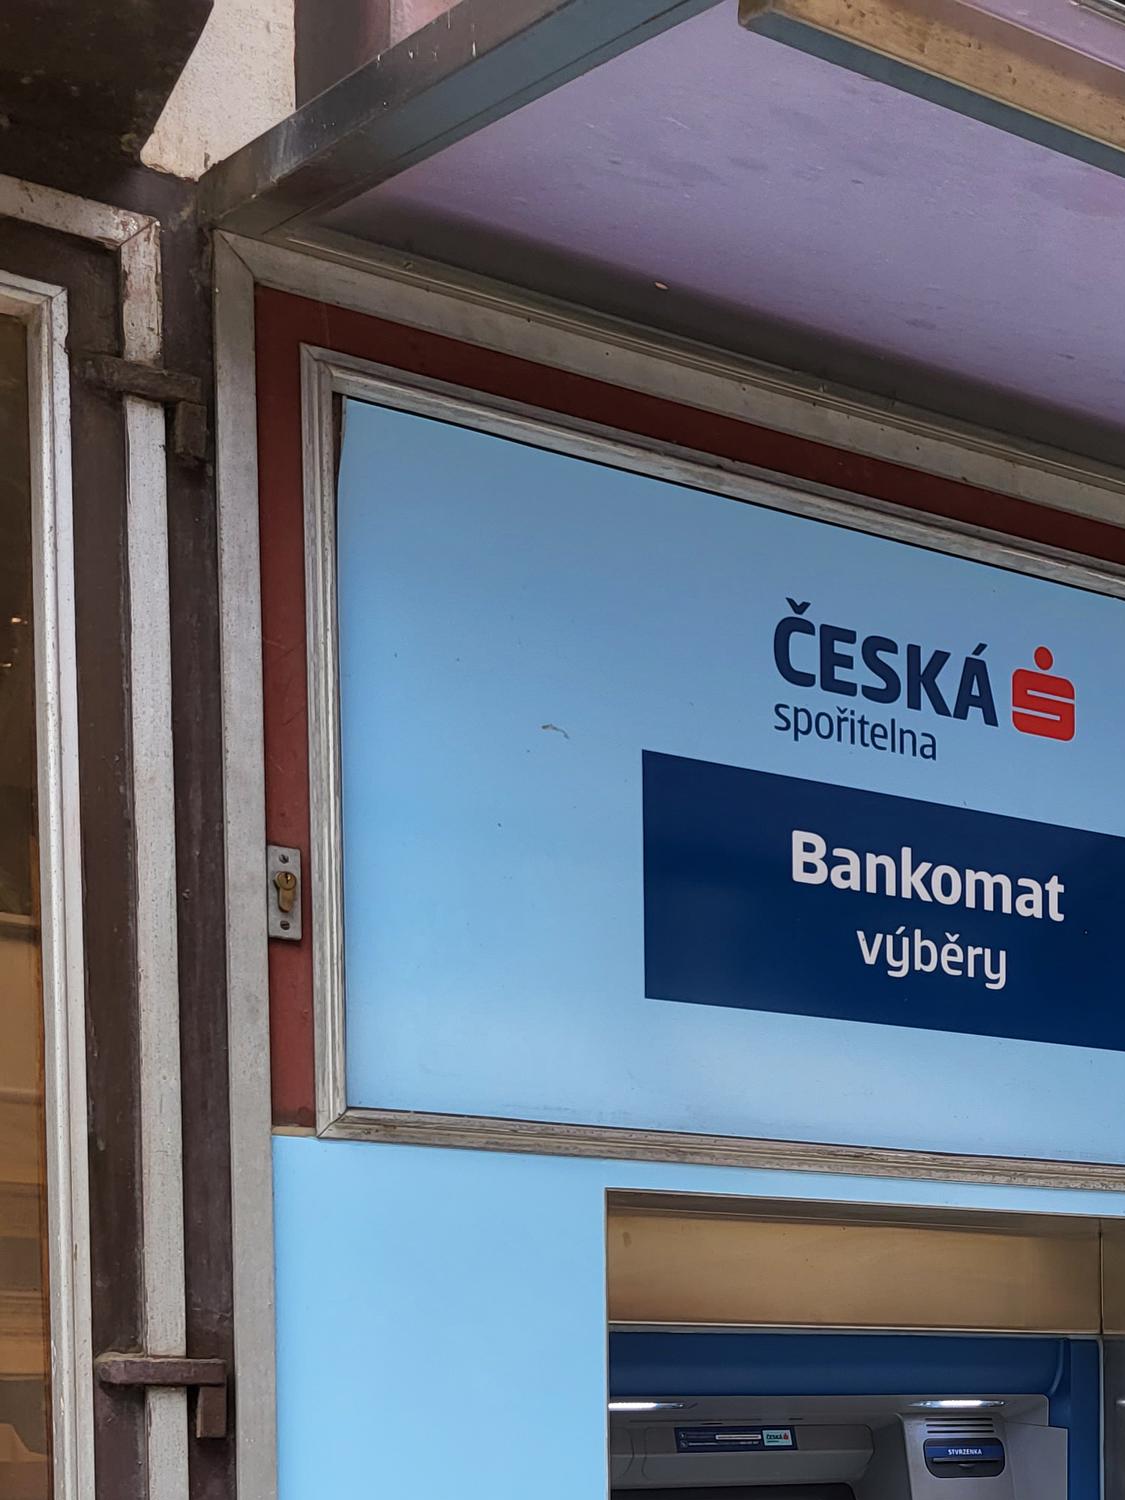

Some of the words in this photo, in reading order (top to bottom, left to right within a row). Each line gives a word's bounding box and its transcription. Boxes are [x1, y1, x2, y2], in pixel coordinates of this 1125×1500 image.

[773, 597, 999, 728] ČESKÁ
[773, 703, 937, 761] spořitelna
[791, 830, 1065, 922] Bankomat
[856, 926, 1007, 990] výběry
[947, 1448, 983, 1456] STVRZENKA
